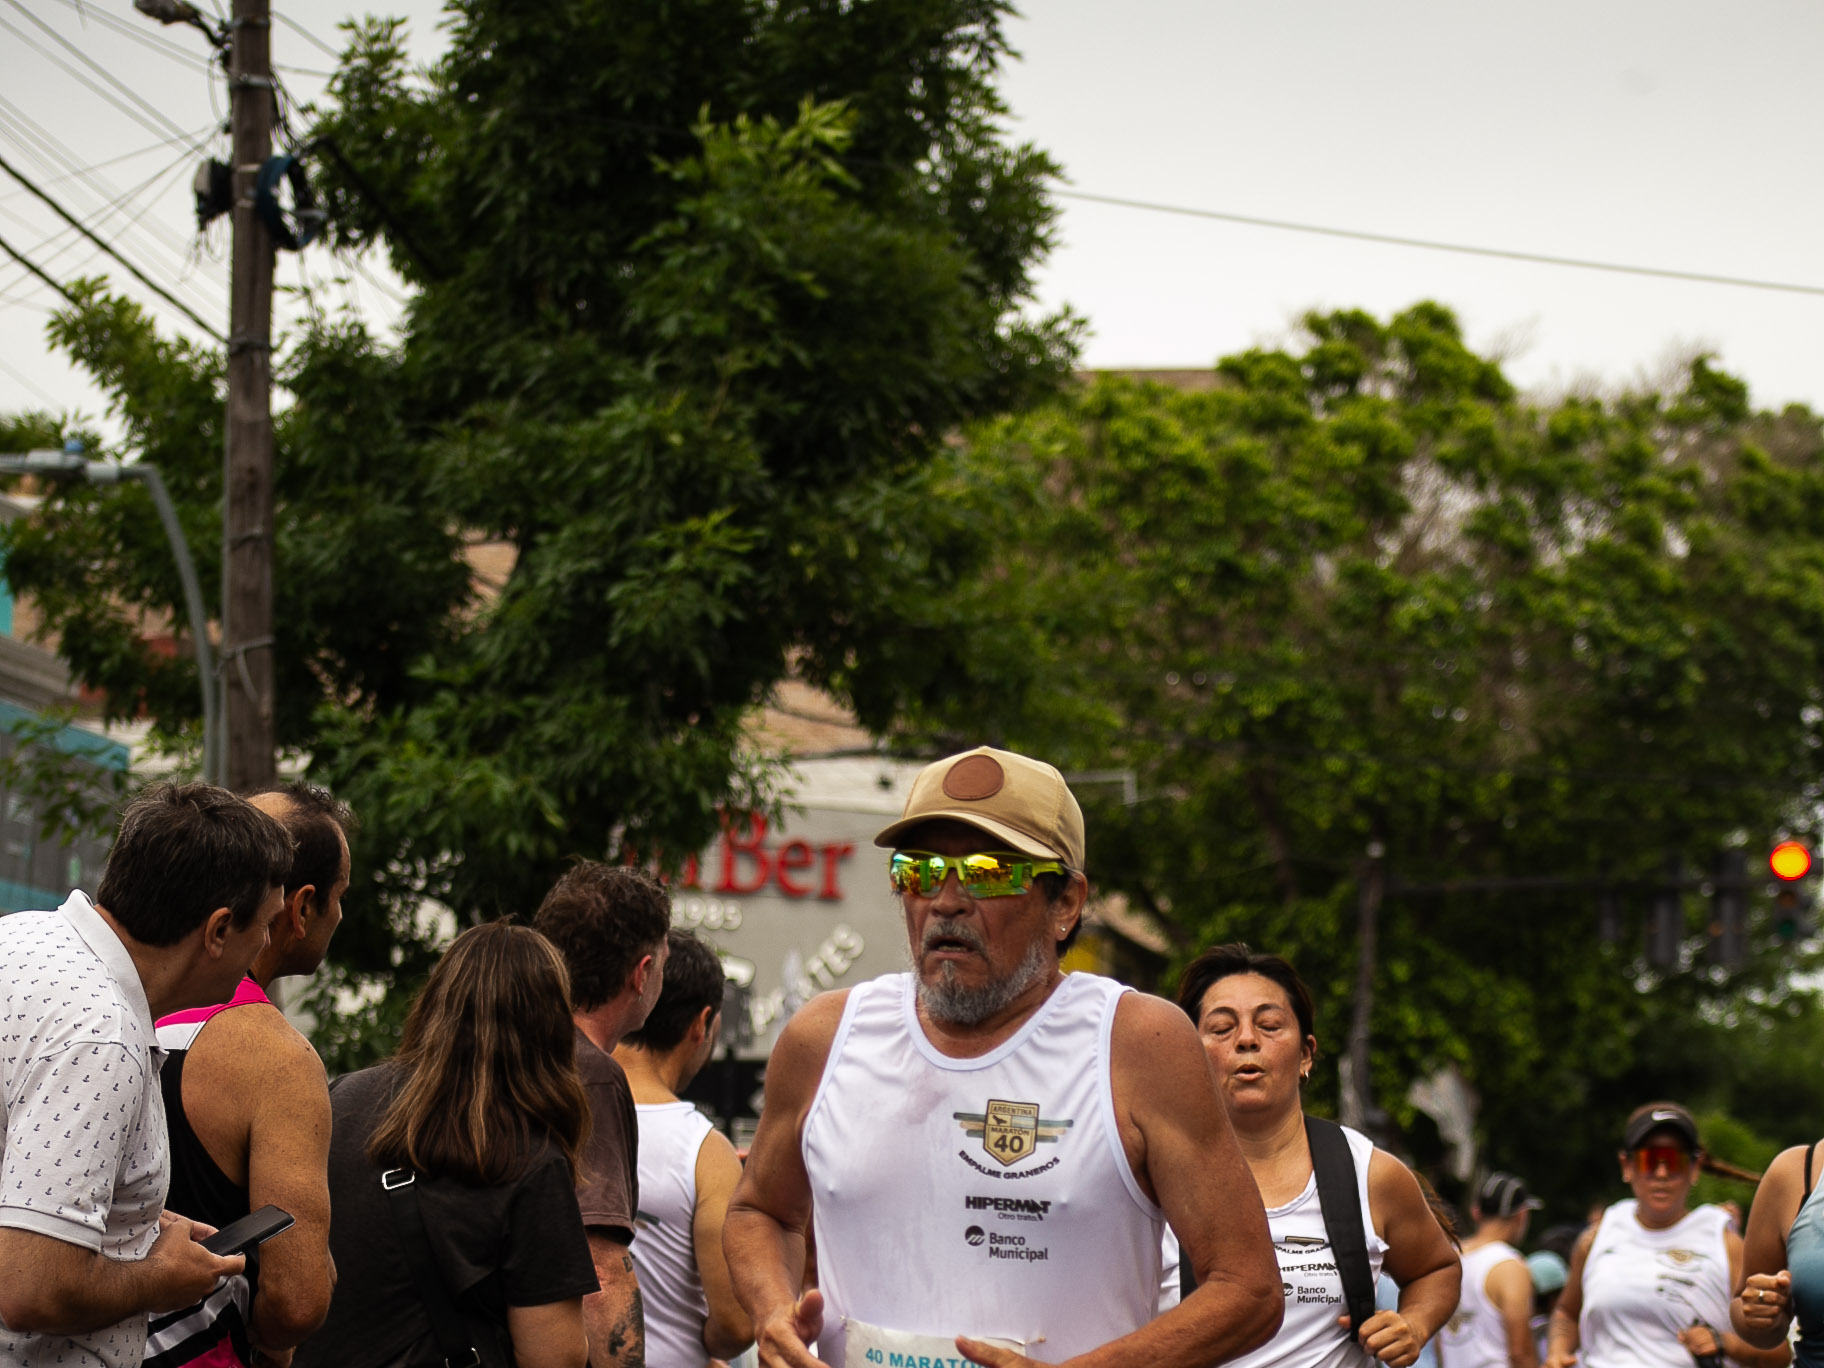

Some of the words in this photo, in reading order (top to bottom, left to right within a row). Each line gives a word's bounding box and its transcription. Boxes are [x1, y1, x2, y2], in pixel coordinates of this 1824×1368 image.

[993, 1134, 1025, 1154] 40
[958, 1149, 1002, 1179] EMPALME
[1003, 1156, 1061, 1180] GRANEROS
[989, 1232, 1026, 1246] Banco
[988, 1246, 1049, 1264] Municipal
[1297, 1286, 1326, 1295] Banco
[1296, 1295, 1342, 1305] Municipal
[865, 1347, 883, 1365] 40
